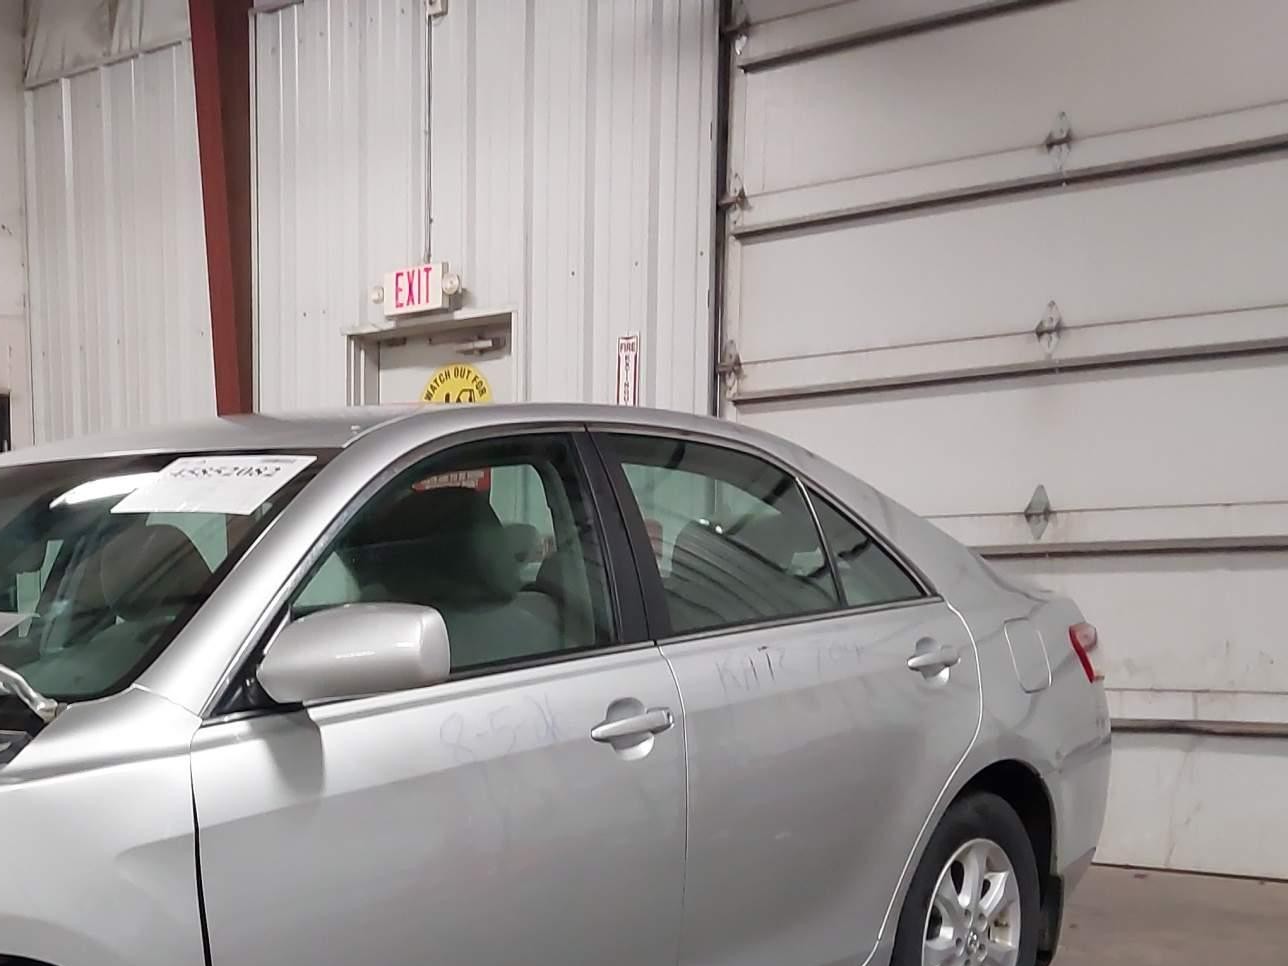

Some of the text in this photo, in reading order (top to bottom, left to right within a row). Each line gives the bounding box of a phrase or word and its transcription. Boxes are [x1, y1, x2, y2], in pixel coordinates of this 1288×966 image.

[395, 267, 433, 309] EXIT
[424, 366, 487, 401] WATCH OUT FOR
